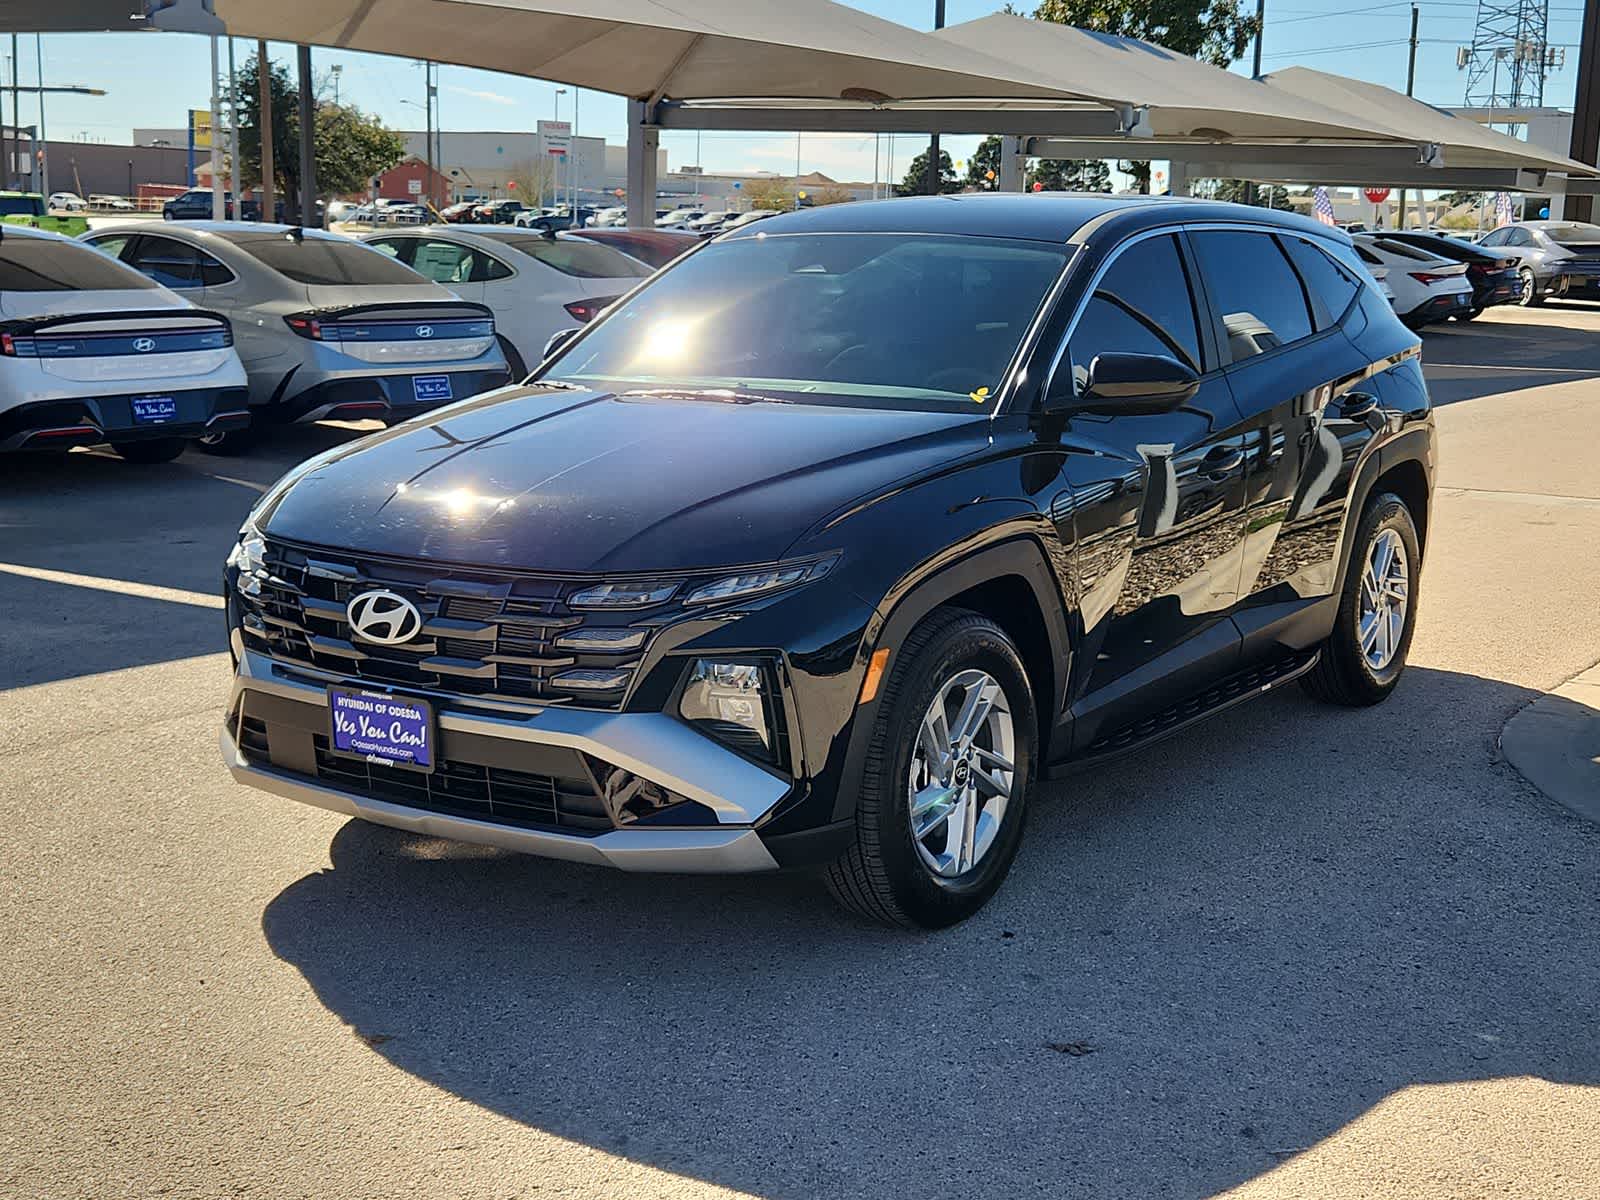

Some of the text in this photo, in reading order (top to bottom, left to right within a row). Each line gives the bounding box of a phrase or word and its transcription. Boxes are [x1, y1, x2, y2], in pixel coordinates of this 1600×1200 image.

[338, 697, 421, 720] HYUNDAI OF ODESSA
[334, 710, 426, 748] Yes You Can!
[351, 739, 414, 757] OdessaHyundai.com
